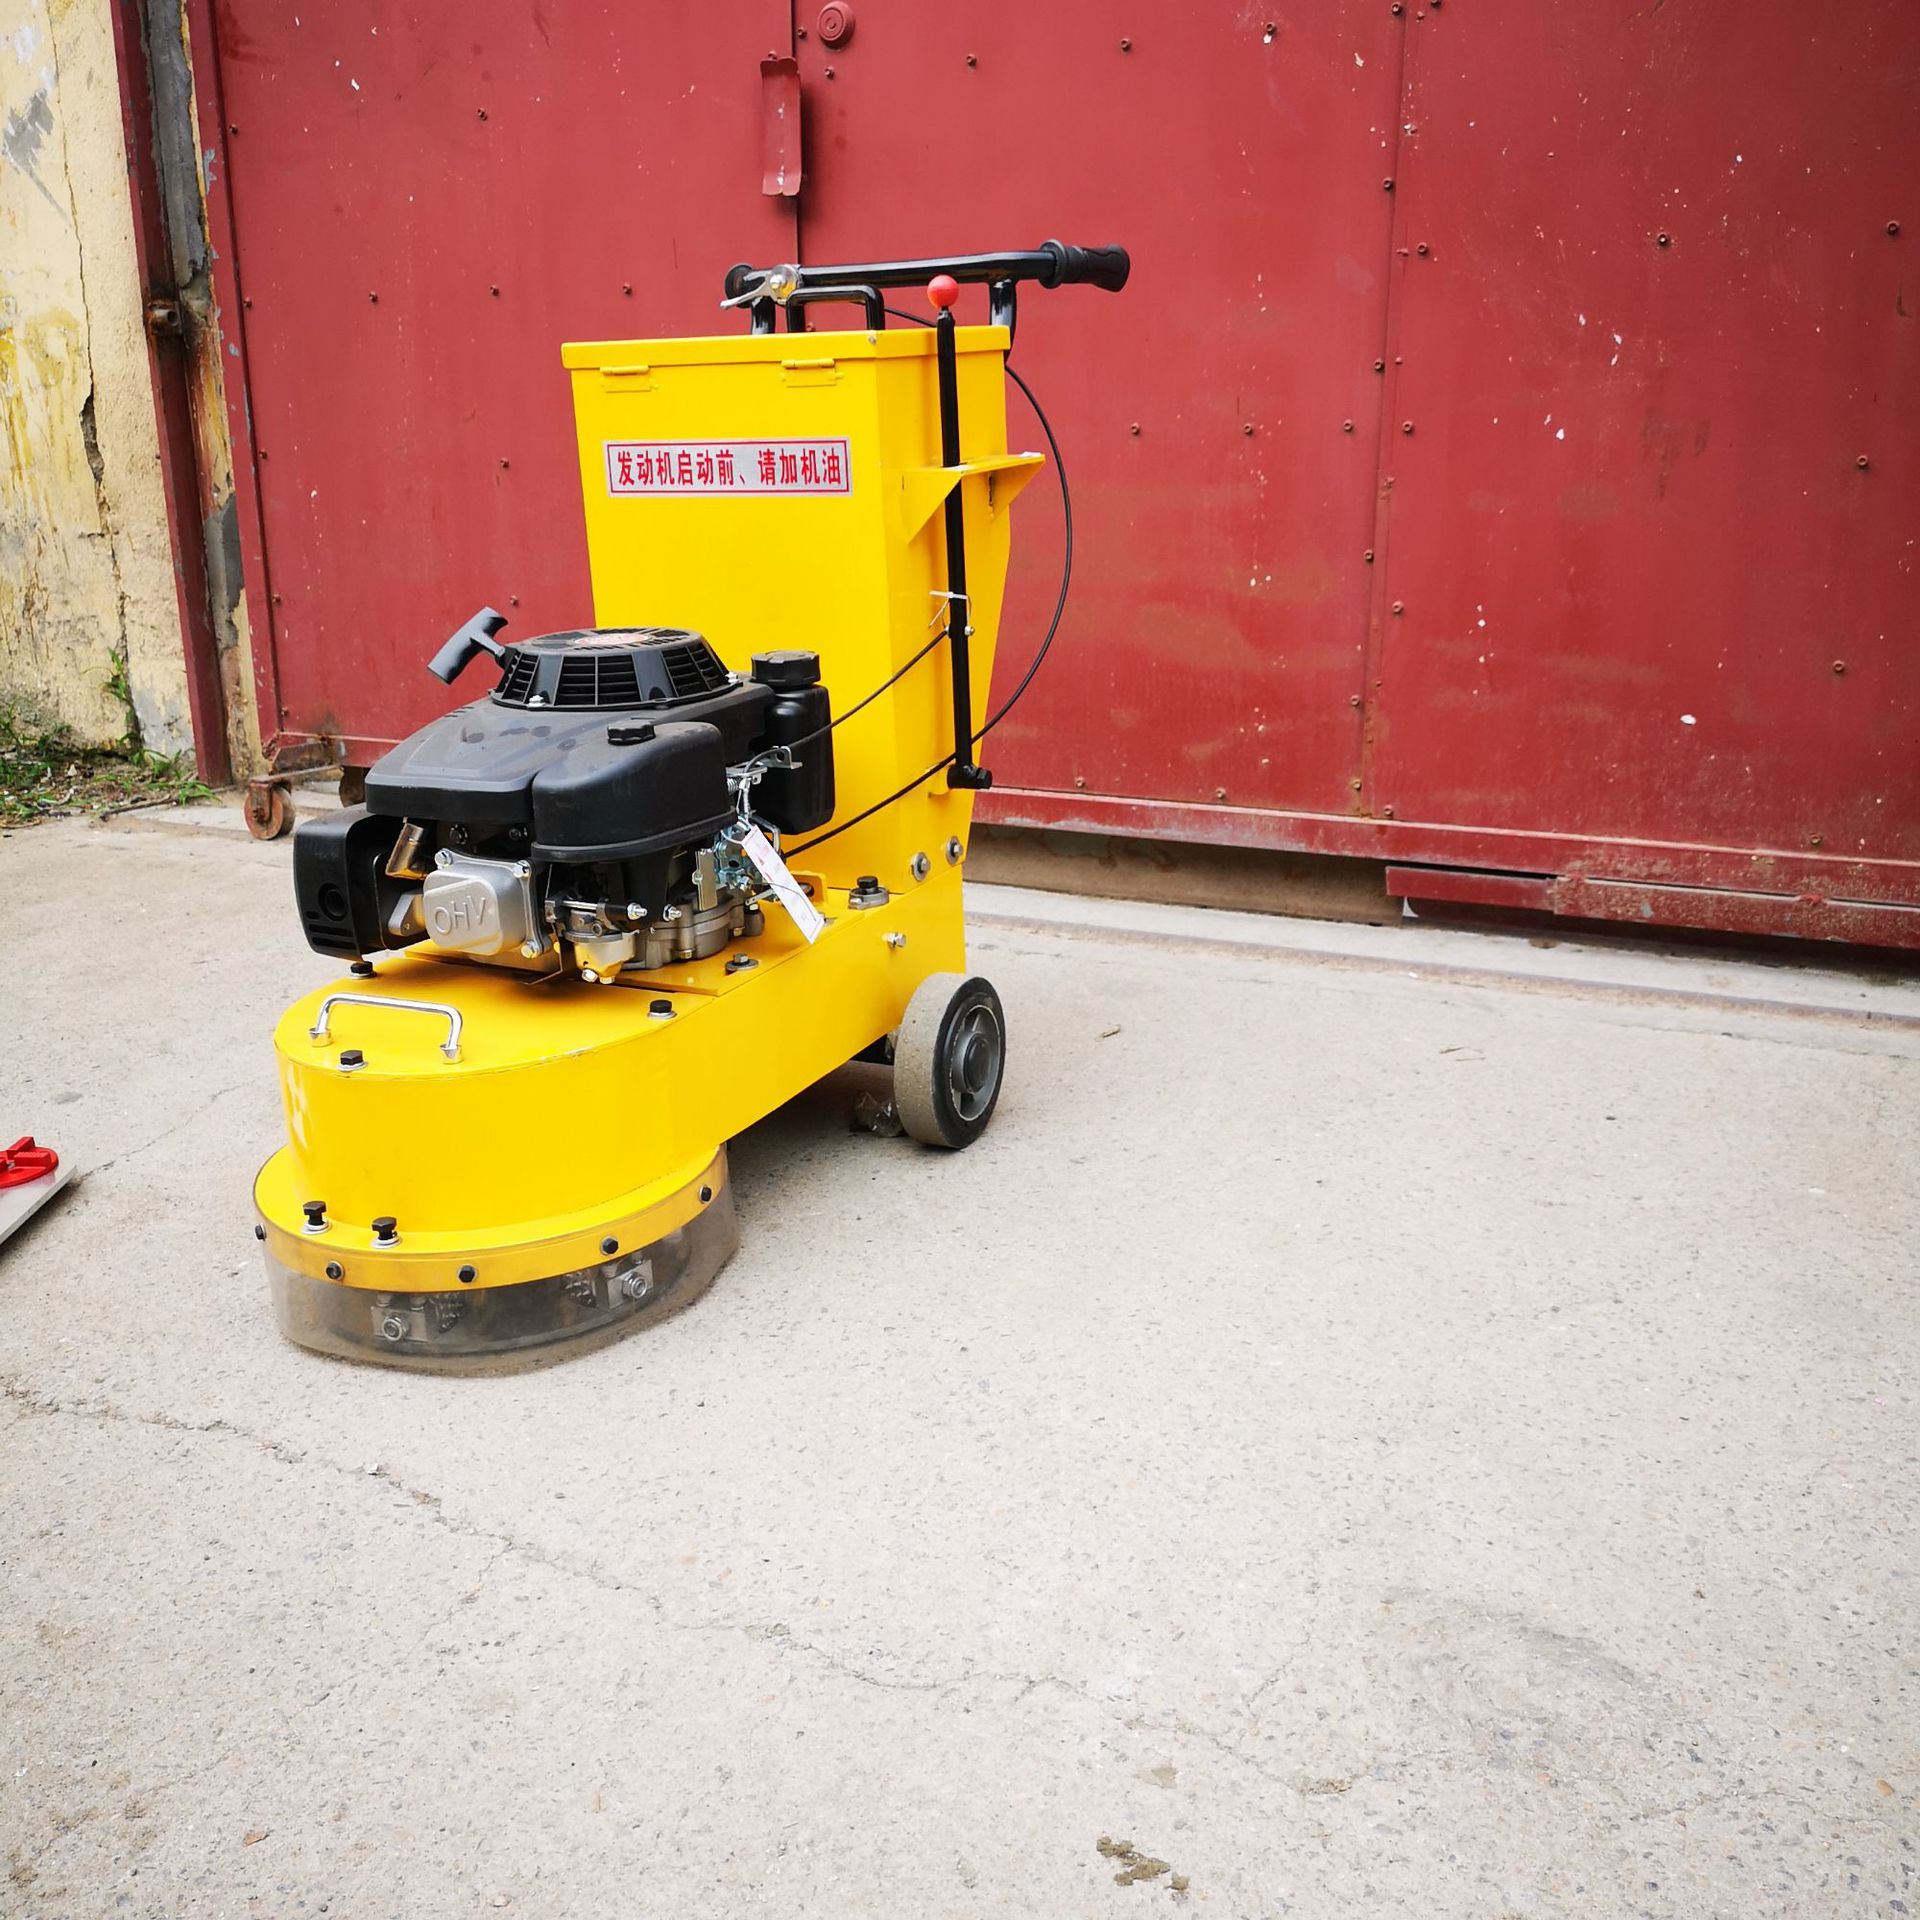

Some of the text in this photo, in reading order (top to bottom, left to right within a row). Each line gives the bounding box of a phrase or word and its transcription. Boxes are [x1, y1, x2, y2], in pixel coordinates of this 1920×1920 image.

[617, 446, 842, 487] 发动机启动前、请加机油
[434, 895, 486, 936] OHV
